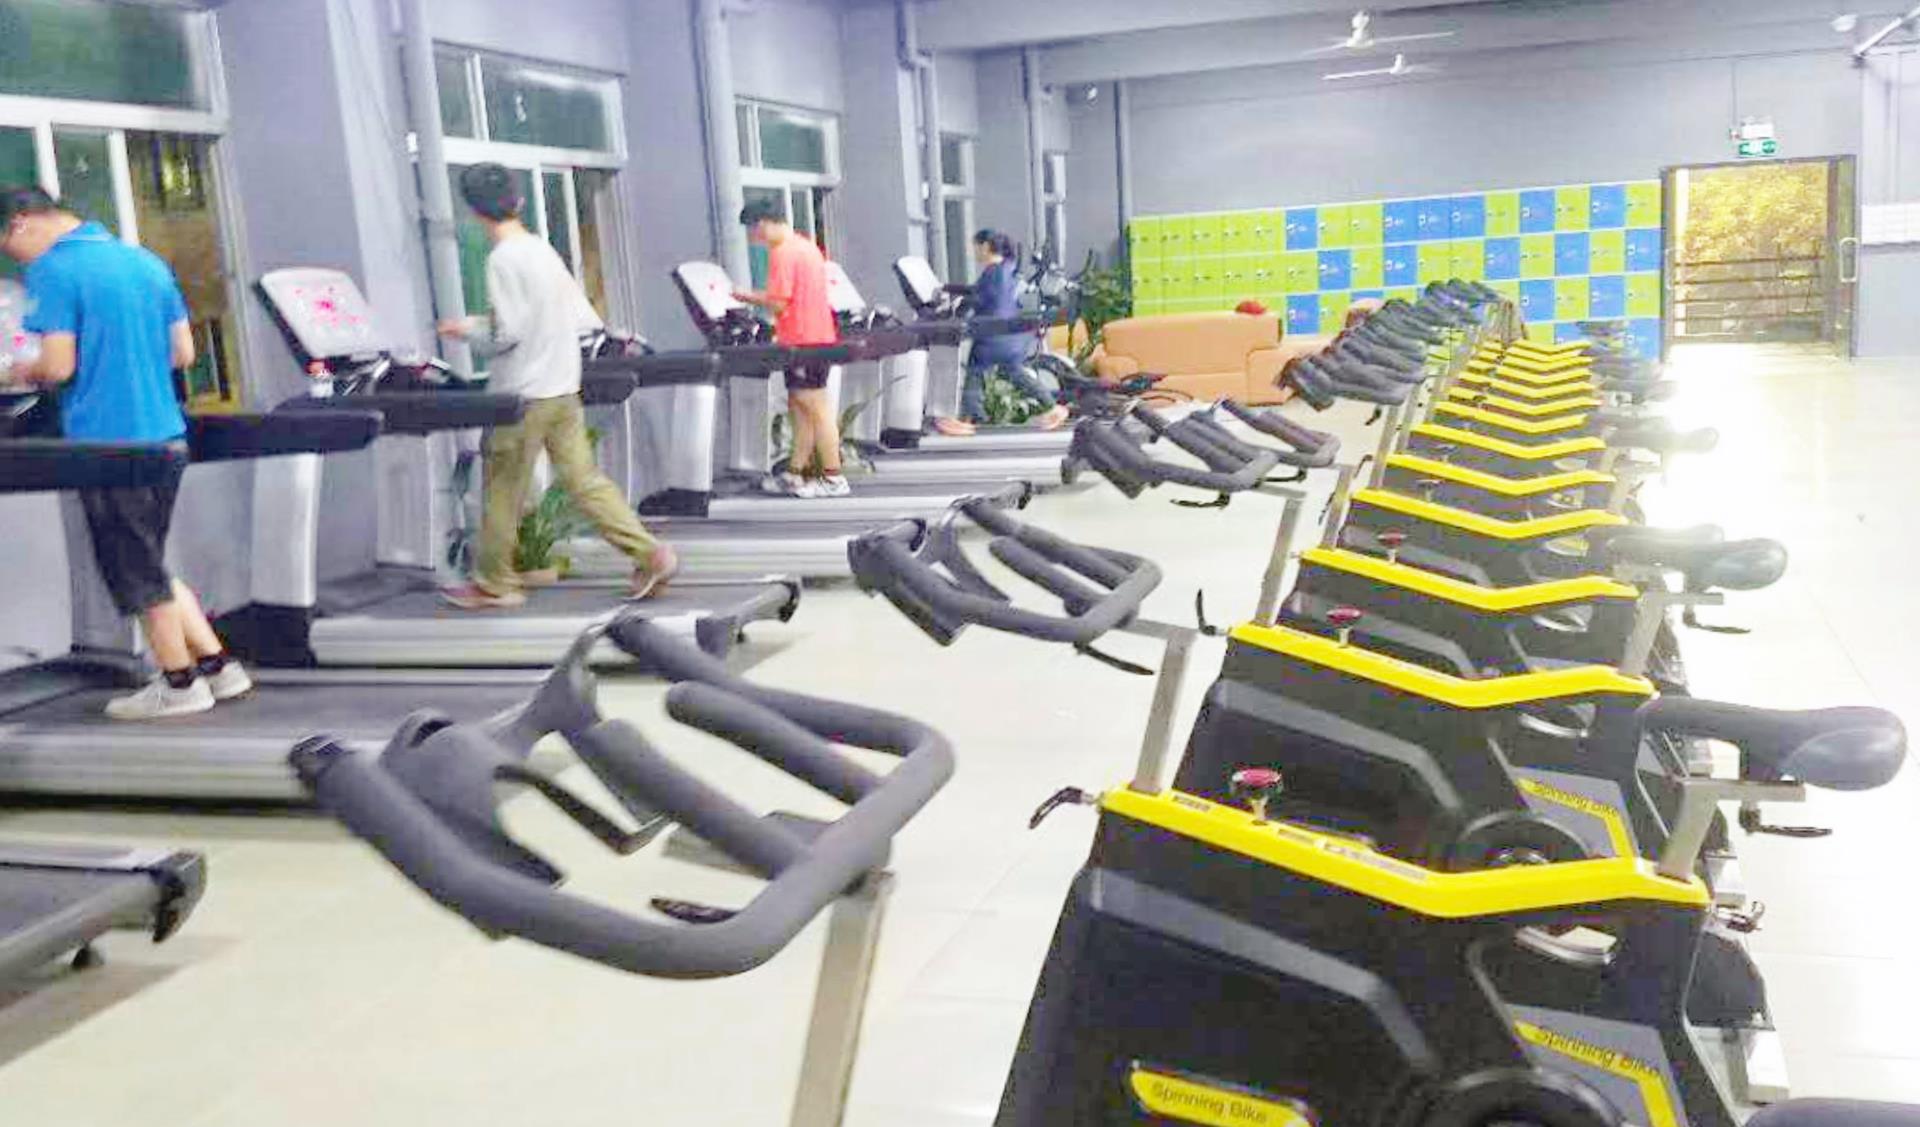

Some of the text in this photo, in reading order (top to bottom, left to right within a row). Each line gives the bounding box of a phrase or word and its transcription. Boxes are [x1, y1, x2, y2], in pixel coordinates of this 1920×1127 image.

[1534, 1027, 1616, 1067] Spinning
[1152, 1081, 1268, 1124] Spinning Bike
